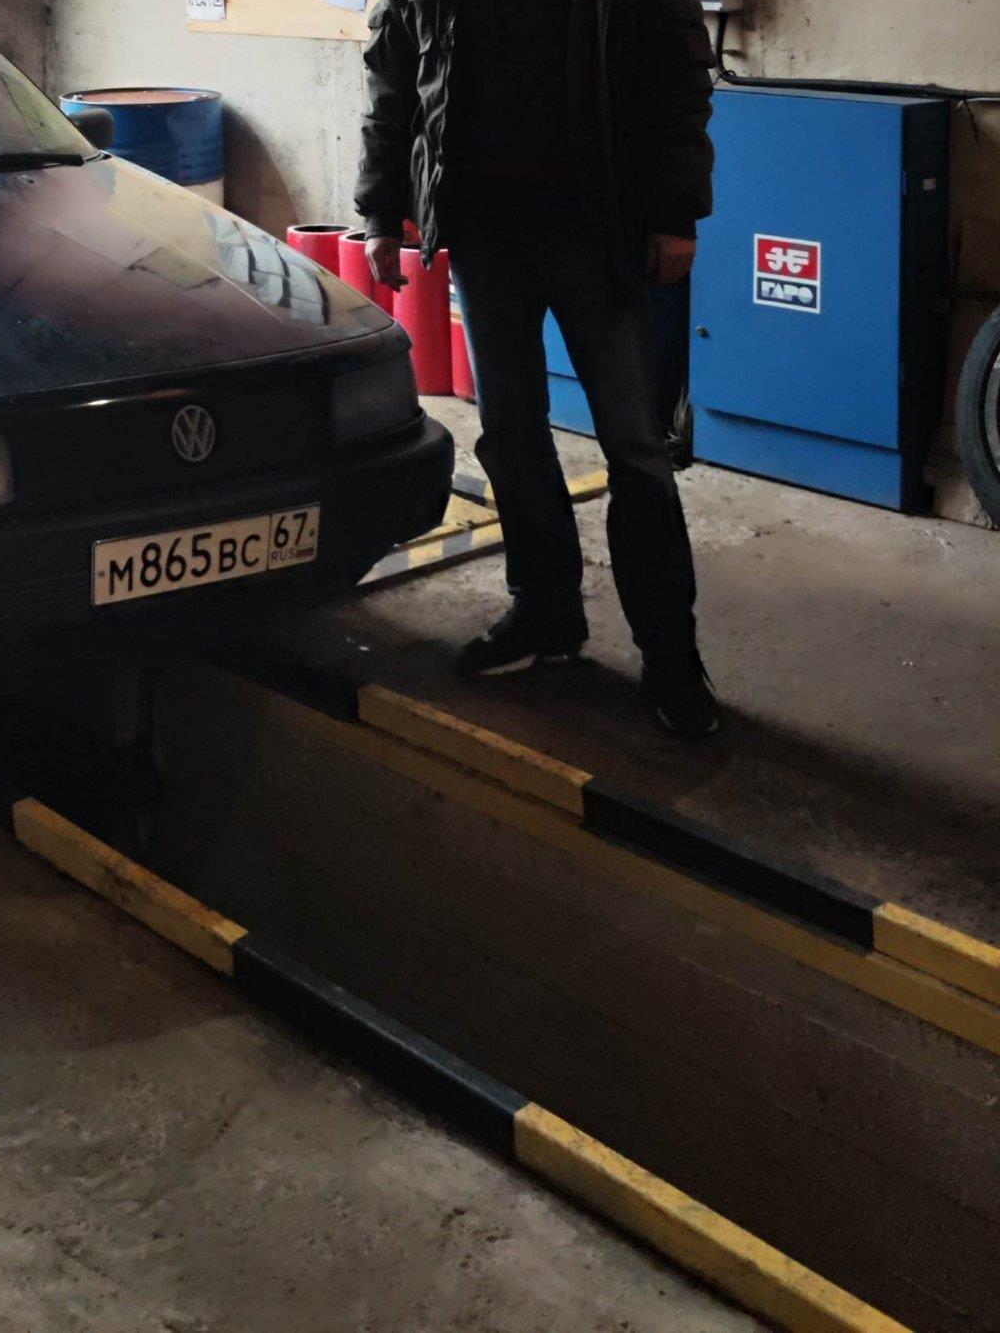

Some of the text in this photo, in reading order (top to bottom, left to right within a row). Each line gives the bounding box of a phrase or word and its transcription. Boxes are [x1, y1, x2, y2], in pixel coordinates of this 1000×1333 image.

[107, 511, 308, 596] М865ВС 67
[271, 547, 296, 562] RUS
